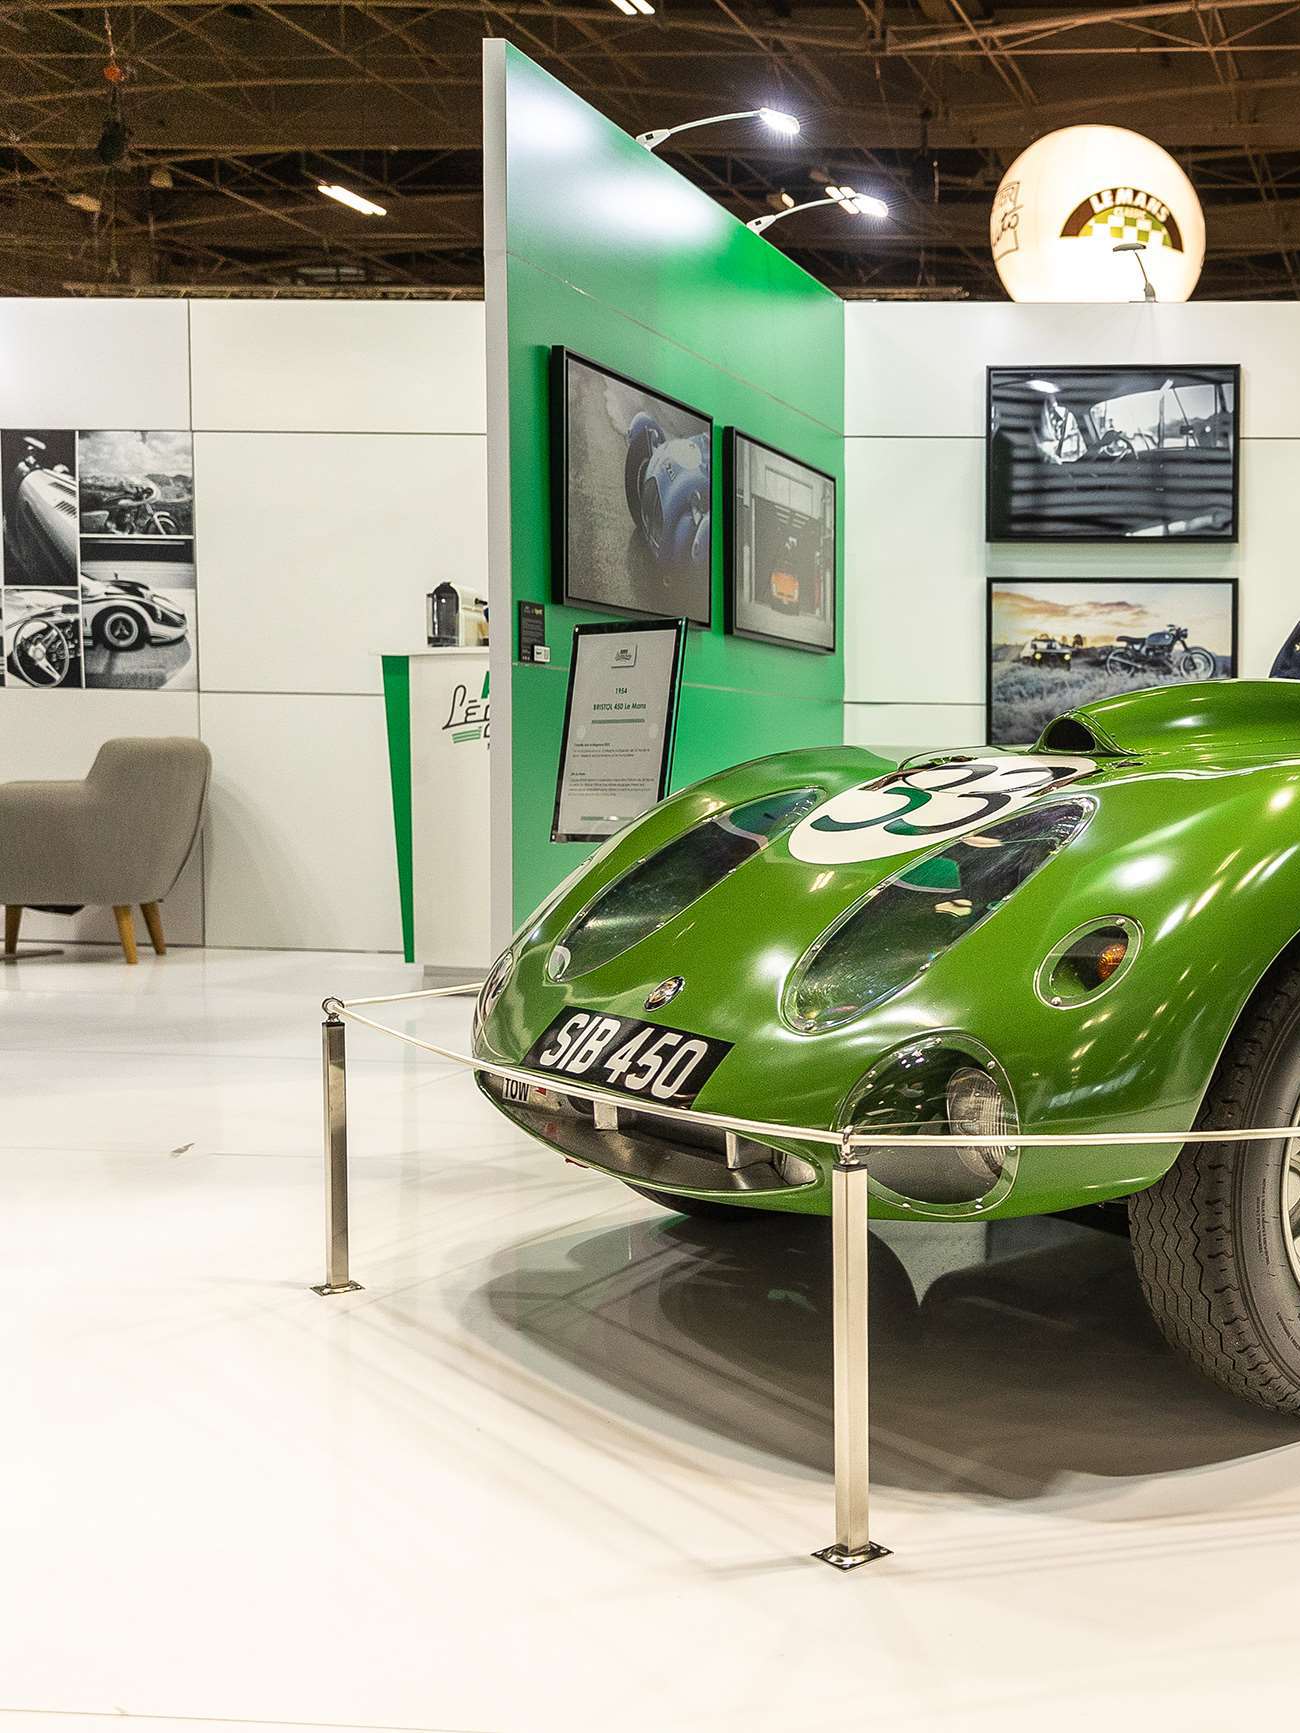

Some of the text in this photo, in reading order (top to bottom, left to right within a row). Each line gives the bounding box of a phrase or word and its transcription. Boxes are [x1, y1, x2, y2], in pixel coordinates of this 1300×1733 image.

[539, 1013, 709, 1099] SIB 450
[504, 1077, 530, 1102] TOW
